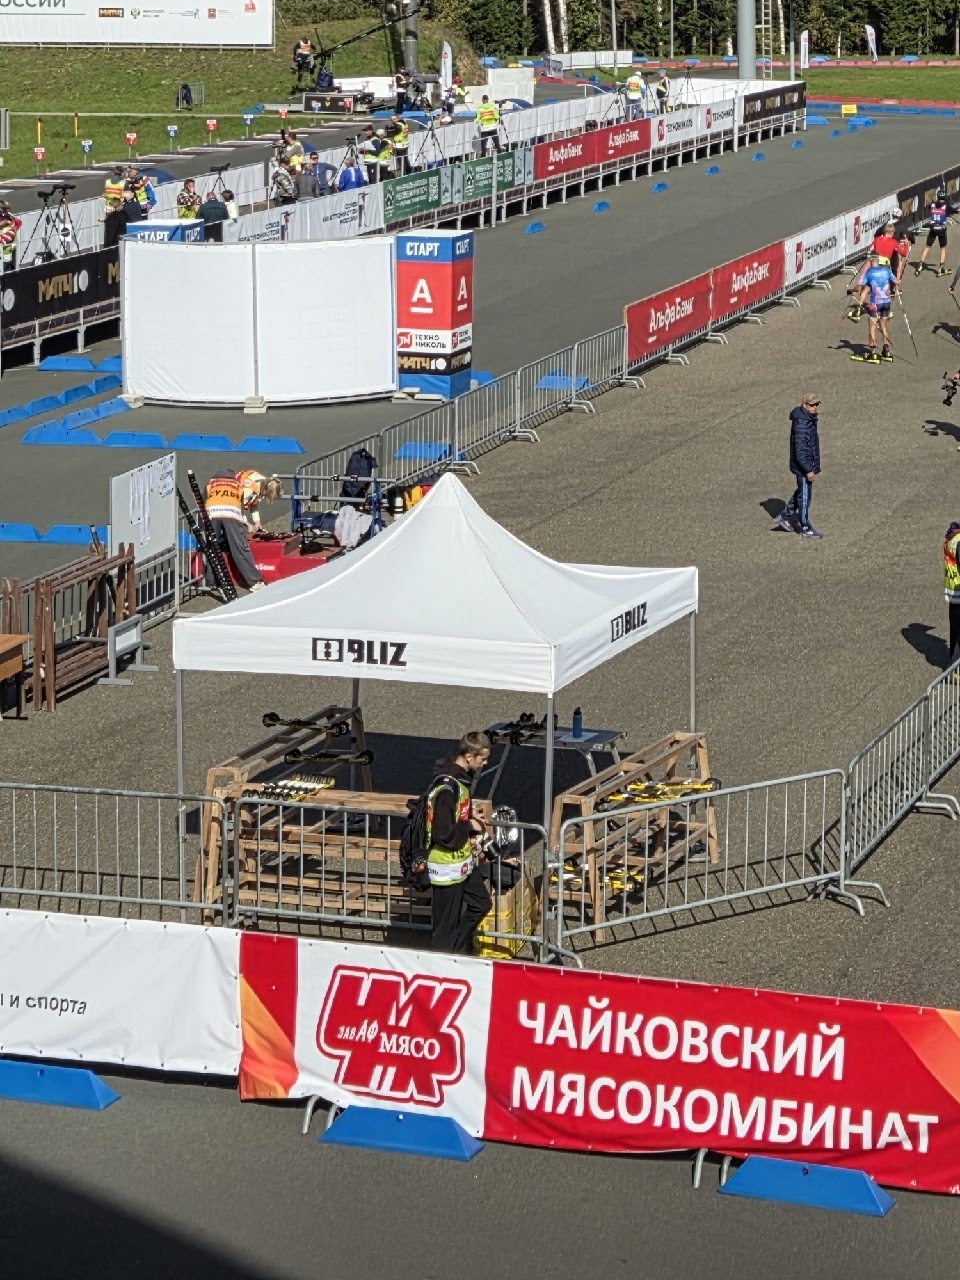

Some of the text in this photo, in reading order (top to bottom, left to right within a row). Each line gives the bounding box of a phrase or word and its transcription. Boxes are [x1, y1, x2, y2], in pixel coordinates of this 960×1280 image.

[406, 241, 440, 256] СТАРТ
[455, 239, 470, 255] СТАРТ
[415, 341, 446, 349] НИКОЛЬ
[624, 601, 648, 635] BLIZ
[9, 994, 87, 1017] и спорта
[378, 1032, 441, 1060] МЯСО
[518, 995, 846, 1081] ЧАЙКОВСКИЙ
[511, 1066, 940, 1153] МЯСОКОМБИНАТ
